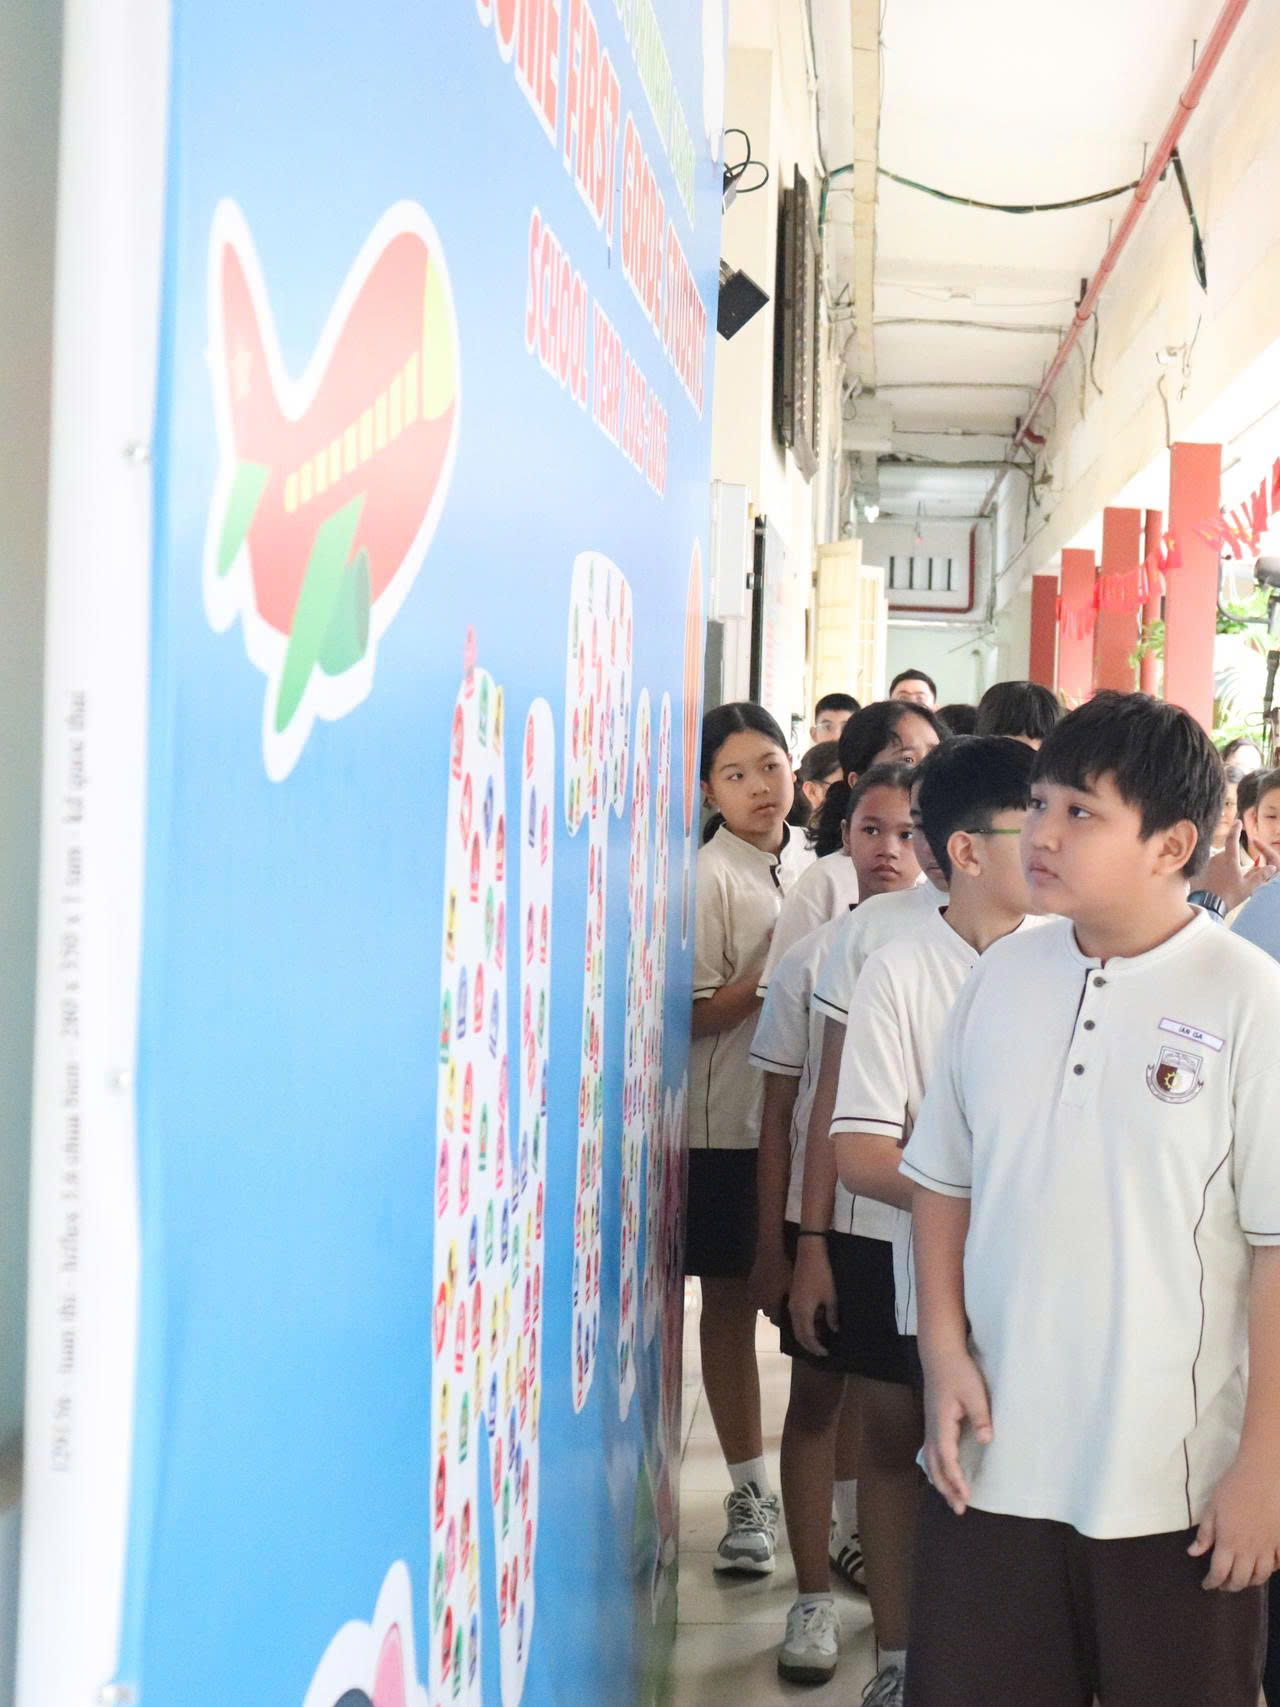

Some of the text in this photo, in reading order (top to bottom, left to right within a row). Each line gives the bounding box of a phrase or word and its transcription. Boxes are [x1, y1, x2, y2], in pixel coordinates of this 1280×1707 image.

[563, 0, 620, 247] FIRST
[620, 111, 665, 337] GRADE
[524, 207, 588, 410] SCHOOL
[592, 299, 622, 450] YEAR
